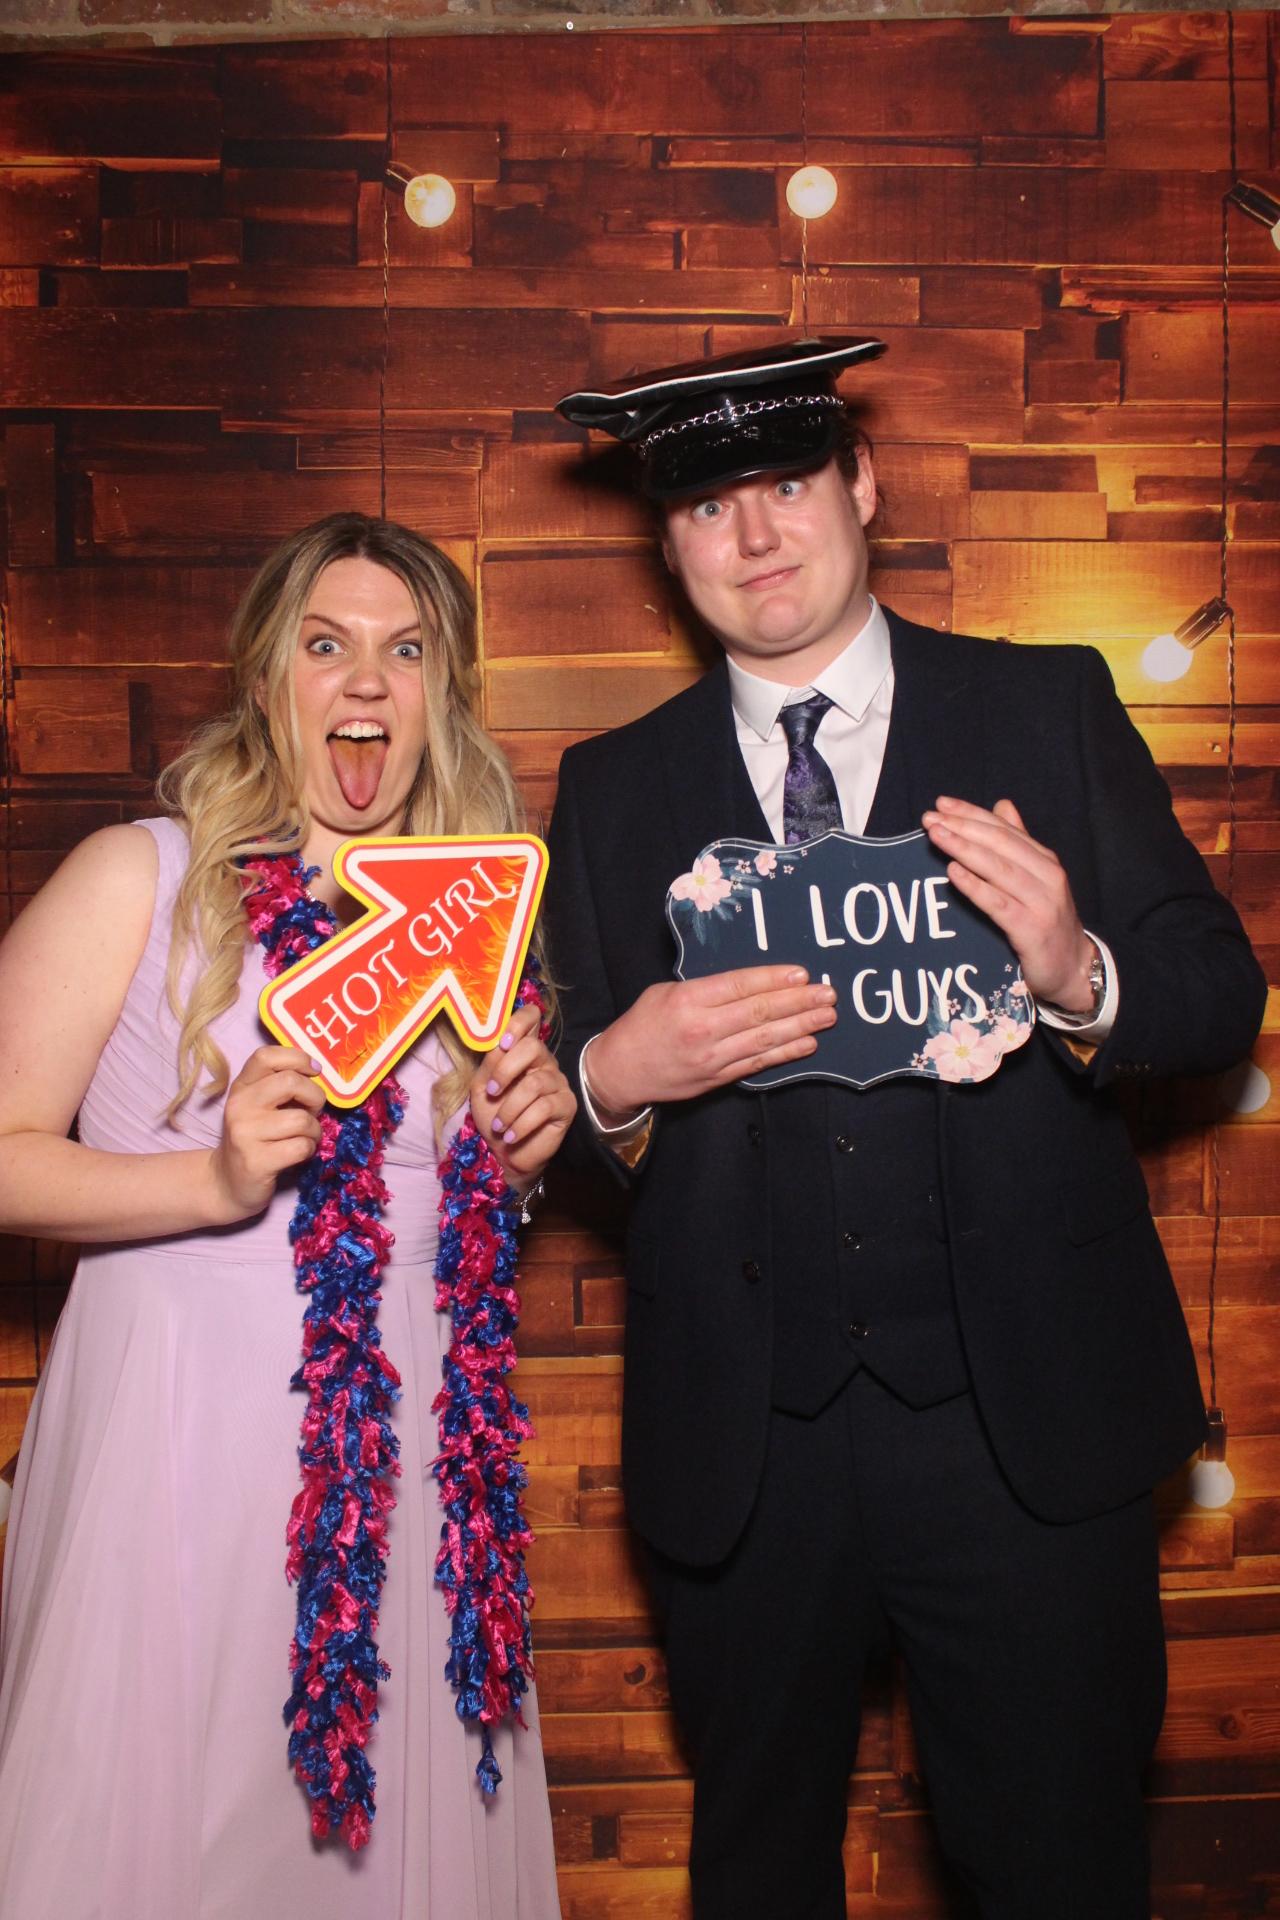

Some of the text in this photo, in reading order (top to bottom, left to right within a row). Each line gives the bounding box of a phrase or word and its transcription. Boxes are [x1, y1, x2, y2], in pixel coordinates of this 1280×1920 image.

[752, 876, 956, 951] I LOVE
[304, 861, 518, 1050] HOT GIRL
[852, 963, 986, 1026] GUYS
